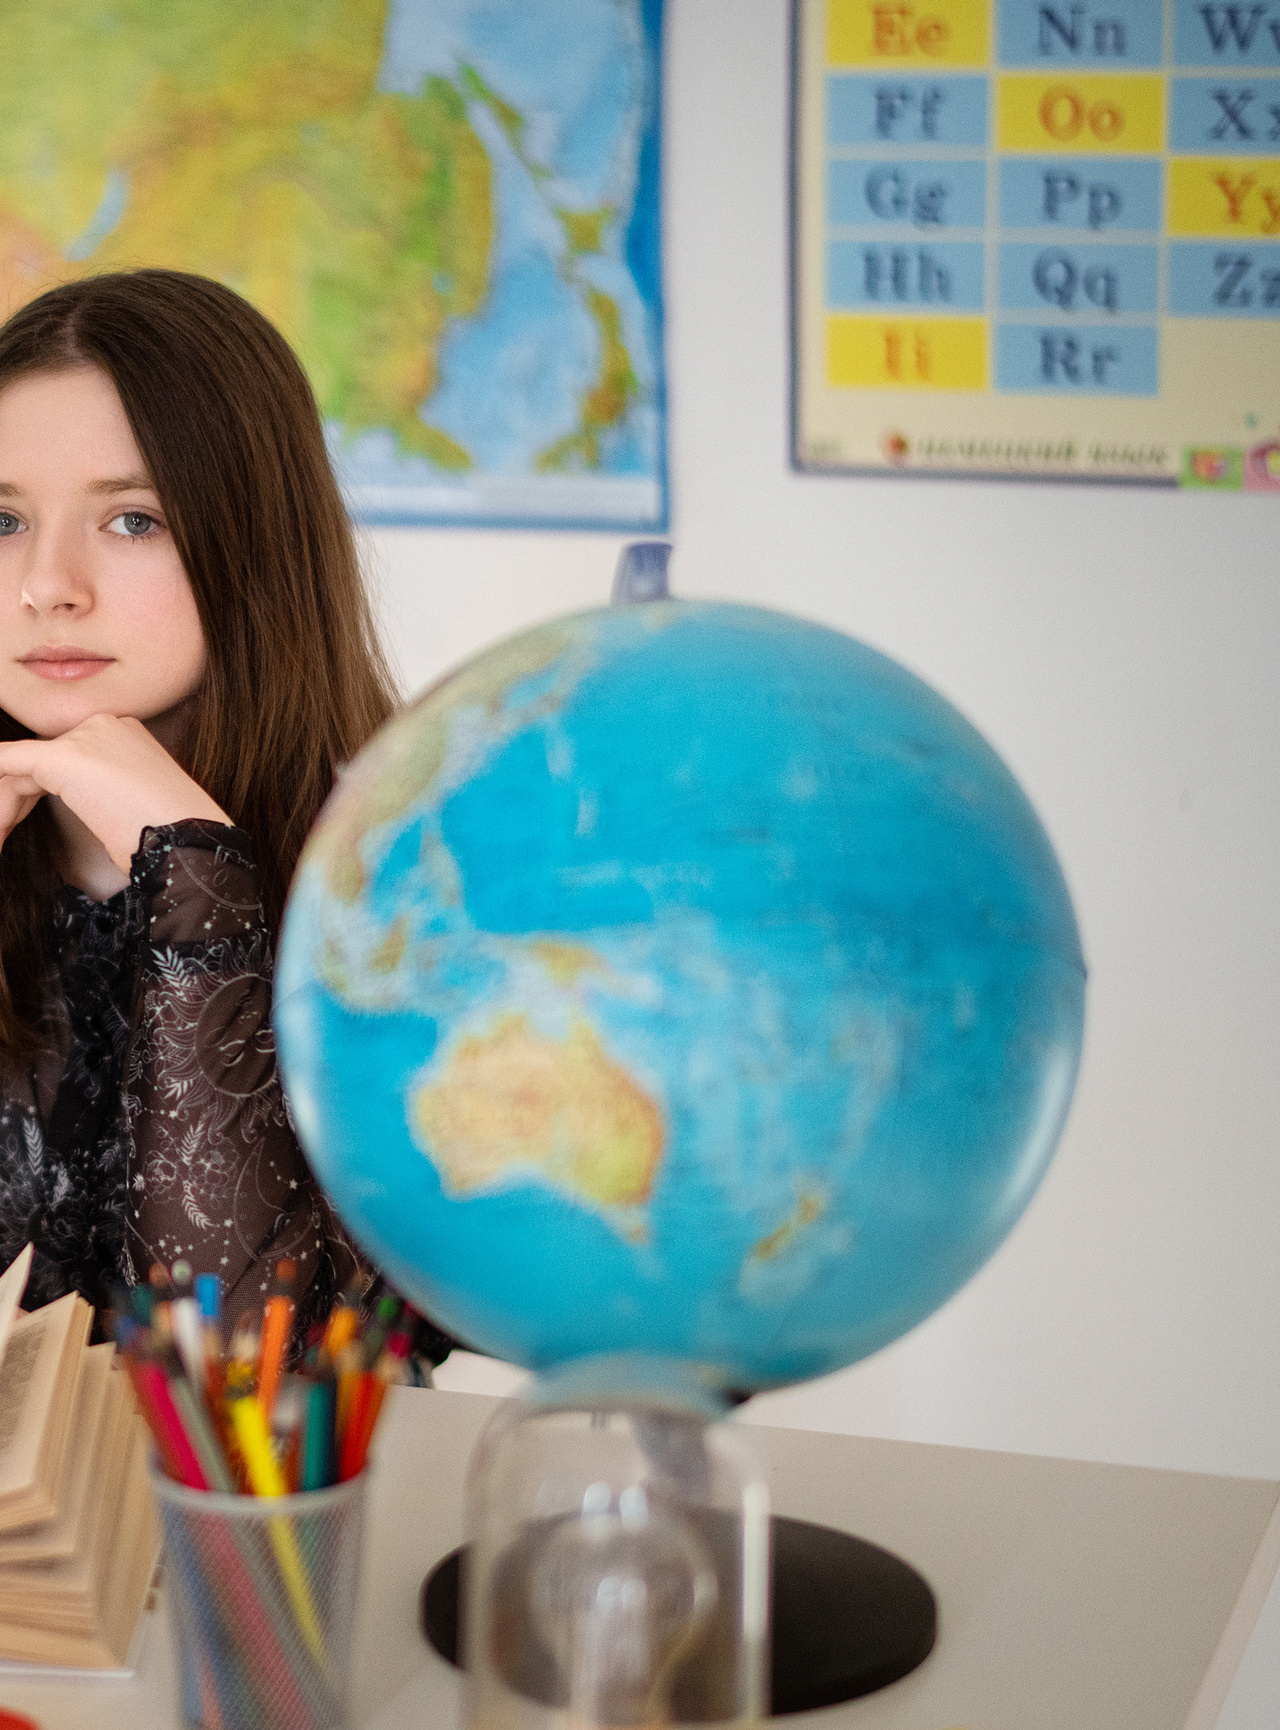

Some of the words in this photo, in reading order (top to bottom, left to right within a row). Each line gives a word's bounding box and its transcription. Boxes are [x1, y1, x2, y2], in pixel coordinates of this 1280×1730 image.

[871, 3, 951, 56] Ee
[1037, 3, 1127, 56] Nn
[1199, 3, 1280, 54] W
[874, 85, 943, 140] Ff
[1038, 85, 1125, 142] Oo
[864, 166, 948, 229] Gg
[1042, 169, 1123, 231] Pp
[863, 248, 952, 302] Hh
[1032, 252, 1119, 315] Qq
[1040, 331, 1119, 385] Rr
